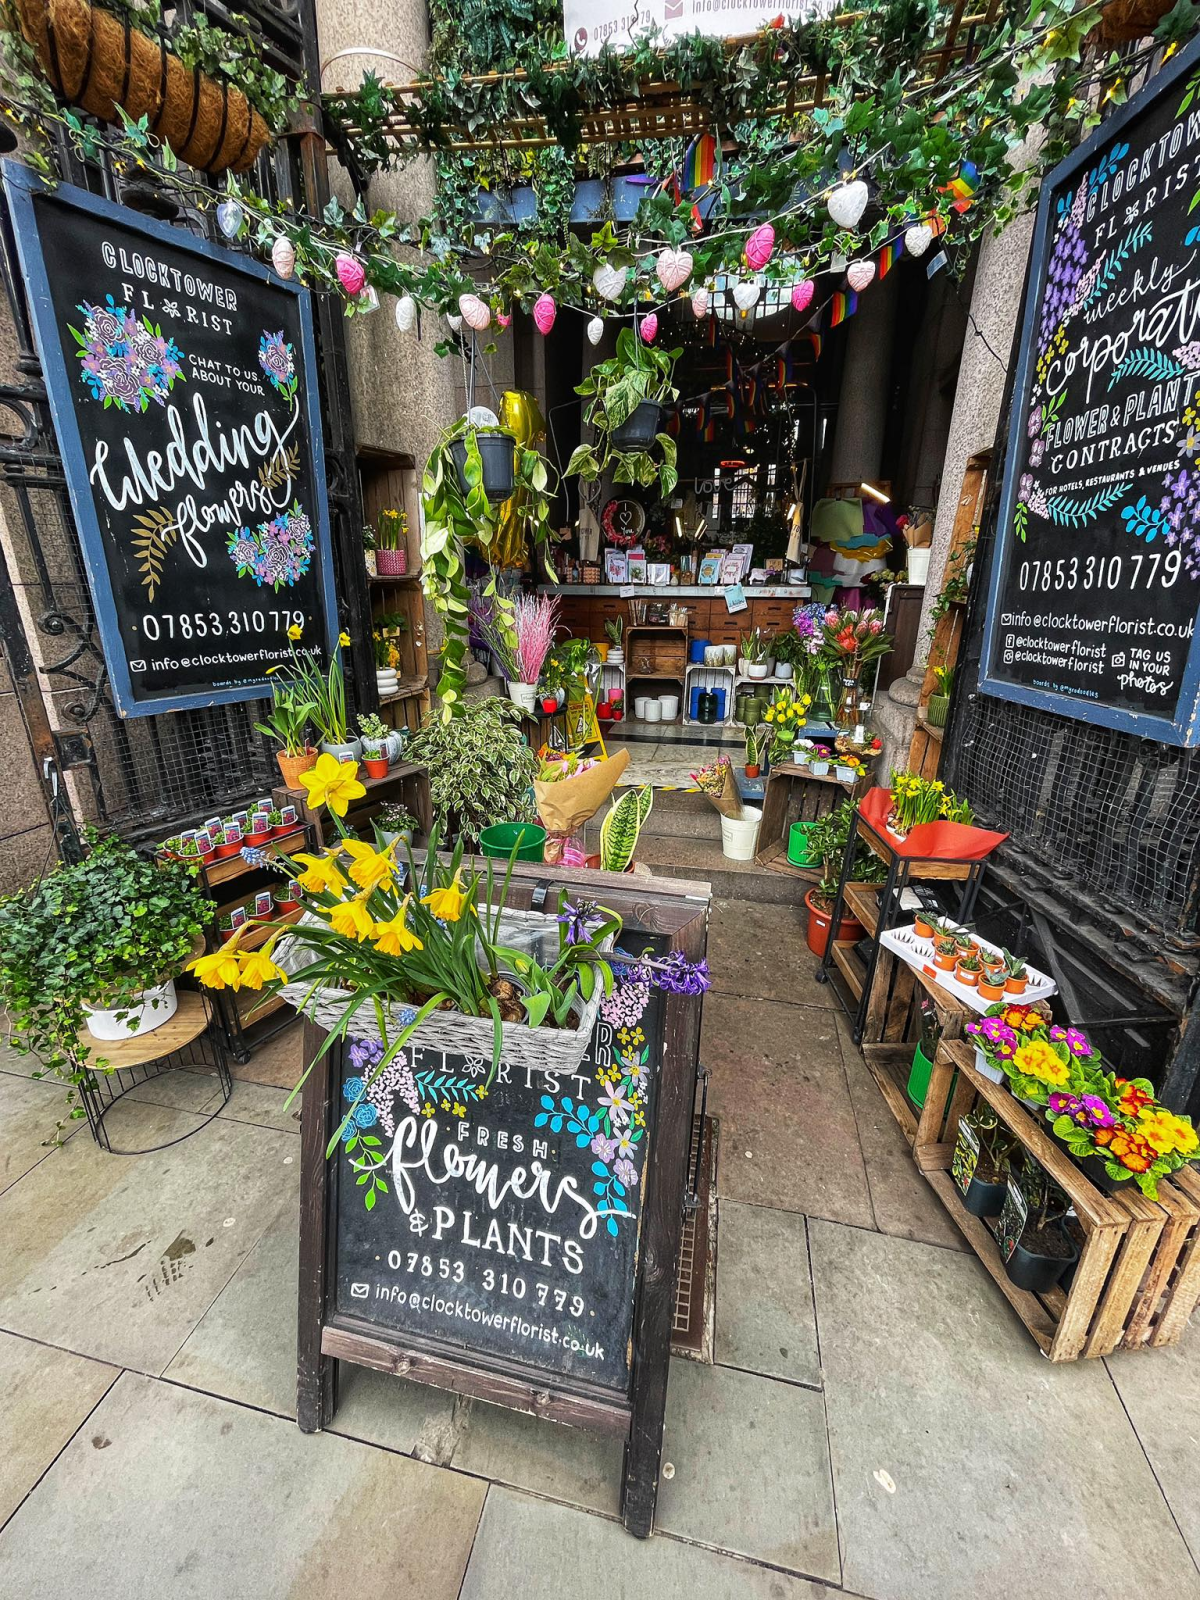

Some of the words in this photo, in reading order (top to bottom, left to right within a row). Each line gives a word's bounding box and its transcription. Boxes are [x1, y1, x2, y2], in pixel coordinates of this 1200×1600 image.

[593, 20, 618, 40] 07853
[101, 241, 238, 311] CLOCKTOWER
[1083, 248, 1197, 324] weekly
[189, 354, 220, 371] CHAT
[225, 363, 241, 377] TO
[192, 363, 233, 388] ABOUT
[235, 379, 265, 396] YOUR
[1045, 404, 1110, 451] FLOWER
[1110, 405, 1121, 427] &
[1051, 421, 1177, 474] CONTRACTS
[1045, 486, 1058, 496] FOR
[1085, 469, 1135, 487] RESTAURANTS
[1138, 466, 1146, 477] &
[1147, 459, 1181, 475] VENUES
[161, 480, 272, 568] flowers
[1019, 556, 1078, 591] 07853
[1083, 554, 1122, 590] 310
[1130, 549, 1182, 590] 779
[143, 612, 223, 641] 07853
[1128, 660, 1140, 671] IN
[1142, 663, 1171, 677] YOUR
[1129, 648, 1151, 661] TAG
[1155, 651, 1171, 664] US
[1117, 671, 1174, 696] photos
[458, 1122, 547, 1158] FRESH
[349, 1116, 636, 1240] flowers
[409, 1209, 428, 1237] &
[432, 1206, 584, 1275] PLANTS
[387, 1250, 465, 1283] 07853
[482, 1269, 526, 1299] 310
[536, 1283, 584, 1317] 779
[375, 1283, 605, 1360] info@clocktowerflorist.co.uk
